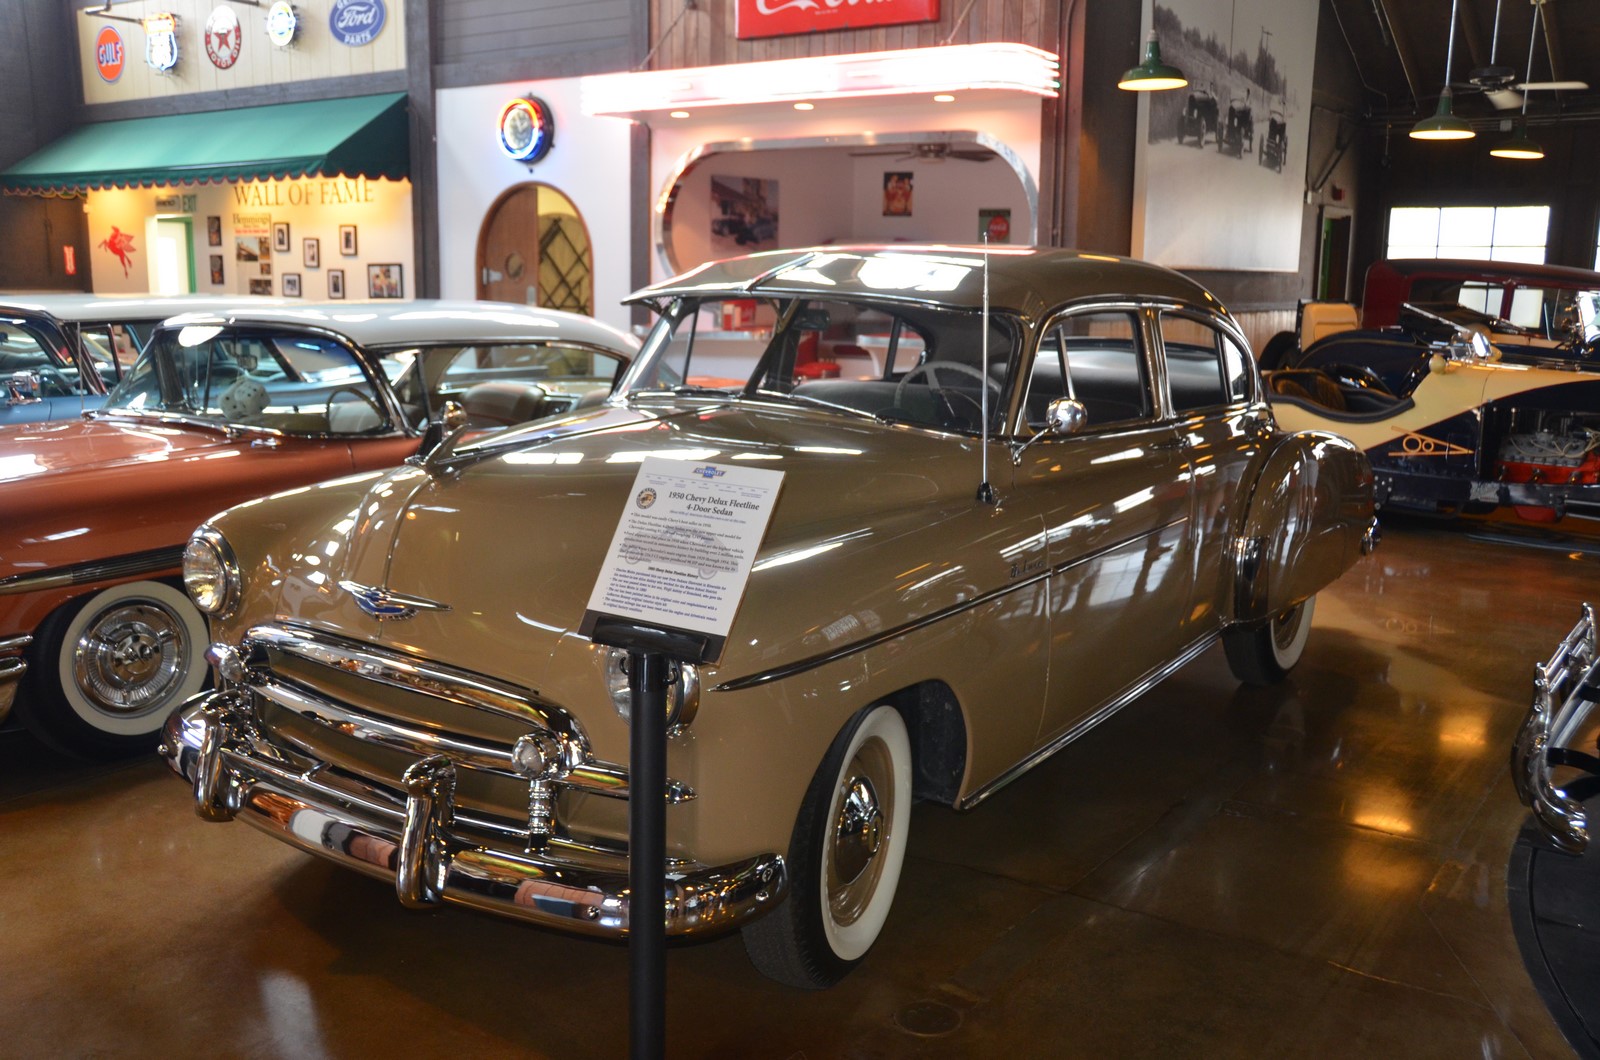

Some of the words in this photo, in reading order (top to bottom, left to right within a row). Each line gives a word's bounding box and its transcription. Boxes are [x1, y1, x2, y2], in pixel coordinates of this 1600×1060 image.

[338, 5, 376, 28] Ford
[344, 31, 372, 44] PARTS
[97, 42, 123, 66] GULF
[207, 44, 233, 67] MOTOR
[234, 186, 284, 207] WALL
[288, 185, 316, 206] OF
[321, 180, 374, 205] FAME
[183, 195, 197, 212] EXIT
[232, 213, 270, 226] Hemmings
[670, 491, 684, 500] 1950
[686, 494, 705, 504] Chevy
[709, 497, 728, 506] Delux
[730, 500, 759, 510] Fleetline
[688, 503, 711, 512] 4-Door
[713, 507, 733, 516] Sedan
